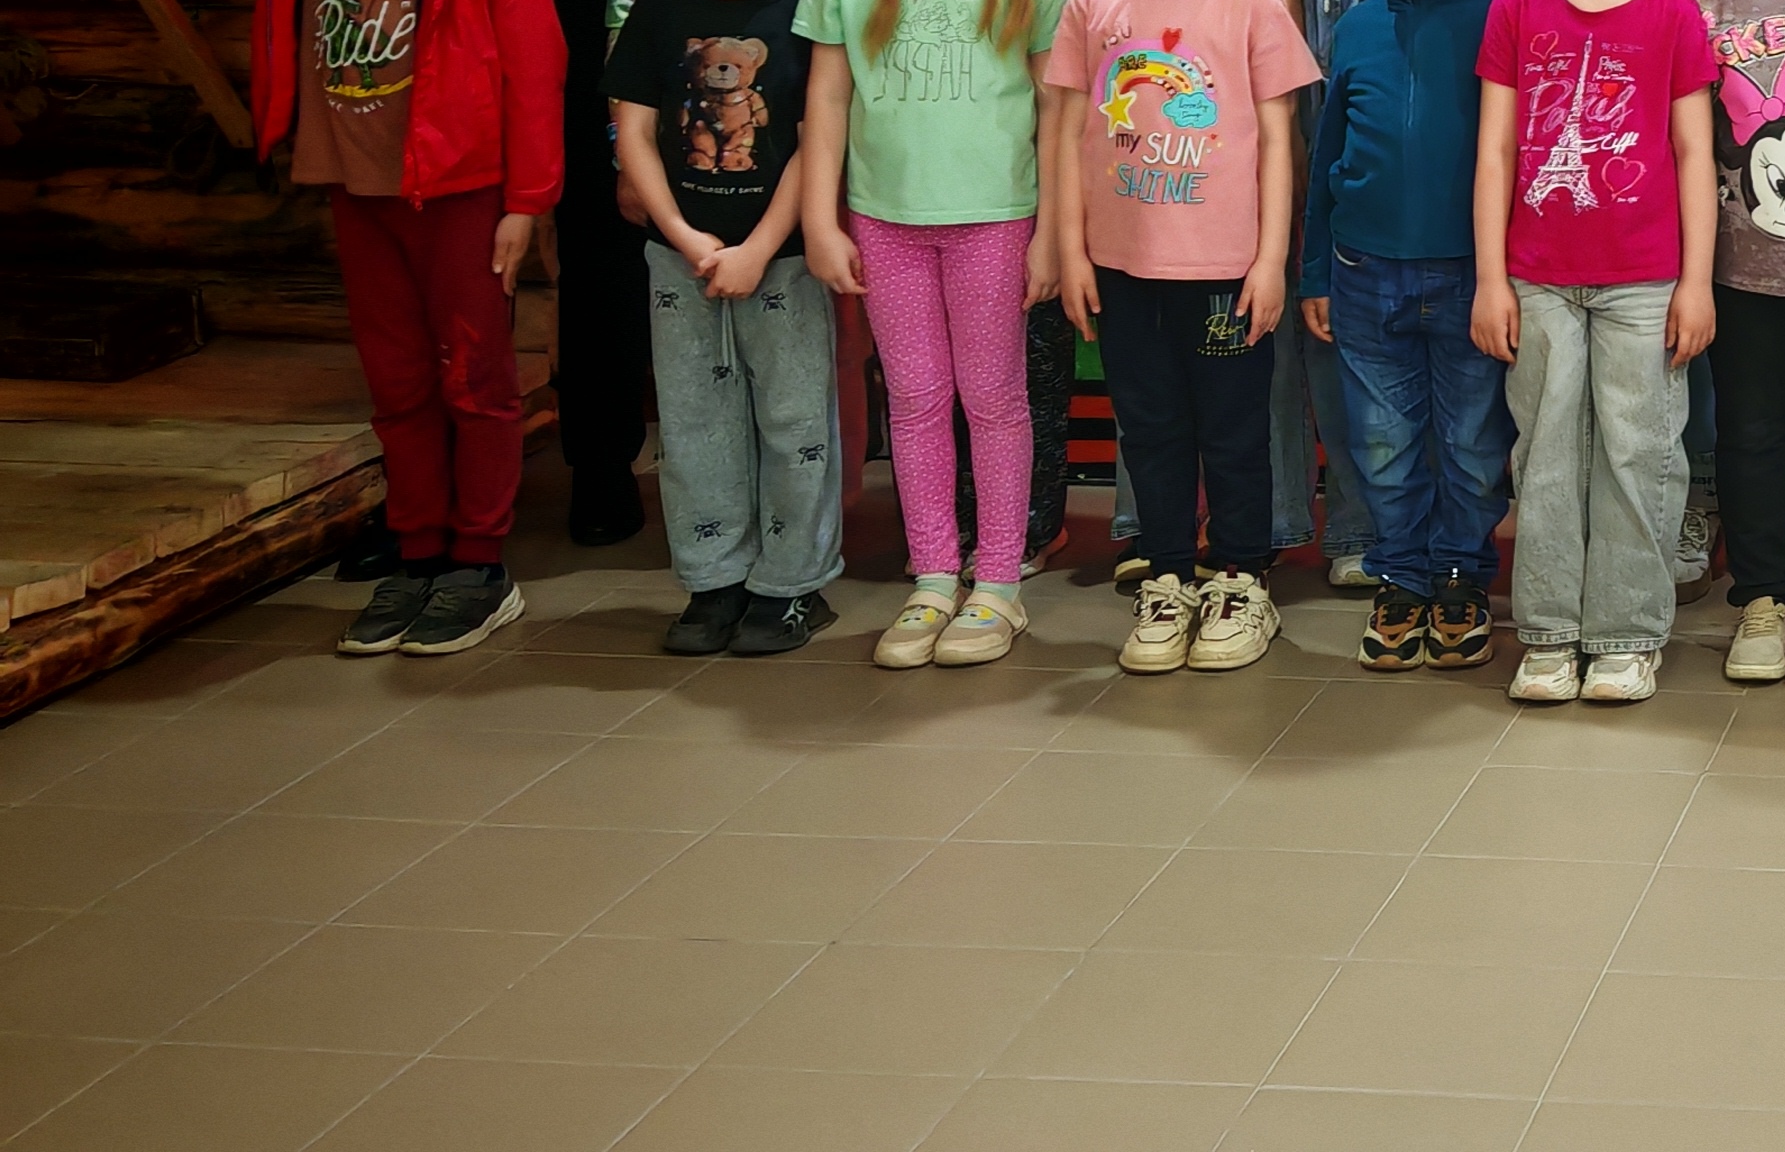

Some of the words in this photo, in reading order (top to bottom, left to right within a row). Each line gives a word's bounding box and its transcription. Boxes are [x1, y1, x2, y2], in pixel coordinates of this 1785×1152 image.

[1116, 132, 1141, 154] my
[1142, 132, 1206, 169] SUN
[1115, 163, 1208, 204] SHINE
